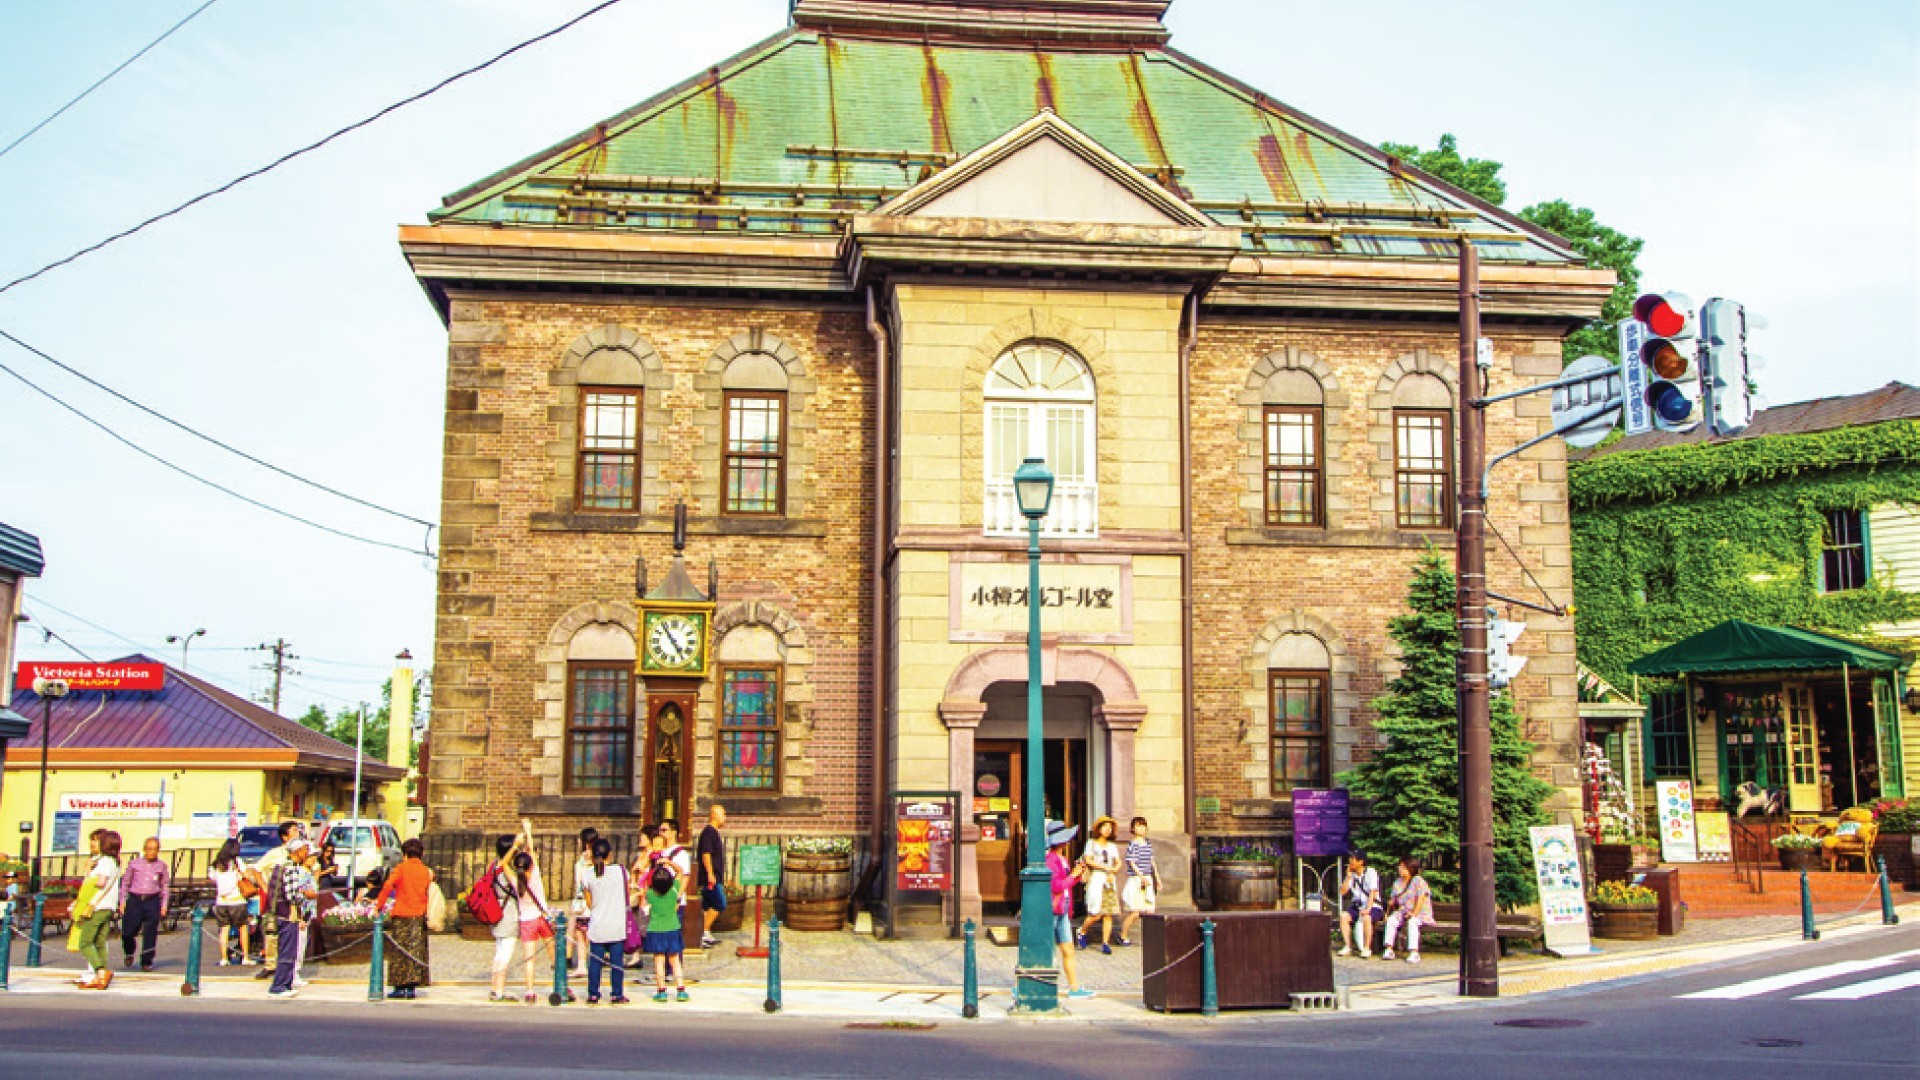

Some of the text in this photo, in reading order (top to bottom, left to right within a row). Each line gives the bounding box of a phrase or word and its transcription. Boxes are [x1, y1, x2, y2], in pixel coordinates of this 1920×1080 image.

[33, 666, 149, 678] Victoria Station
[69, 798, 119, 809] Victoria
